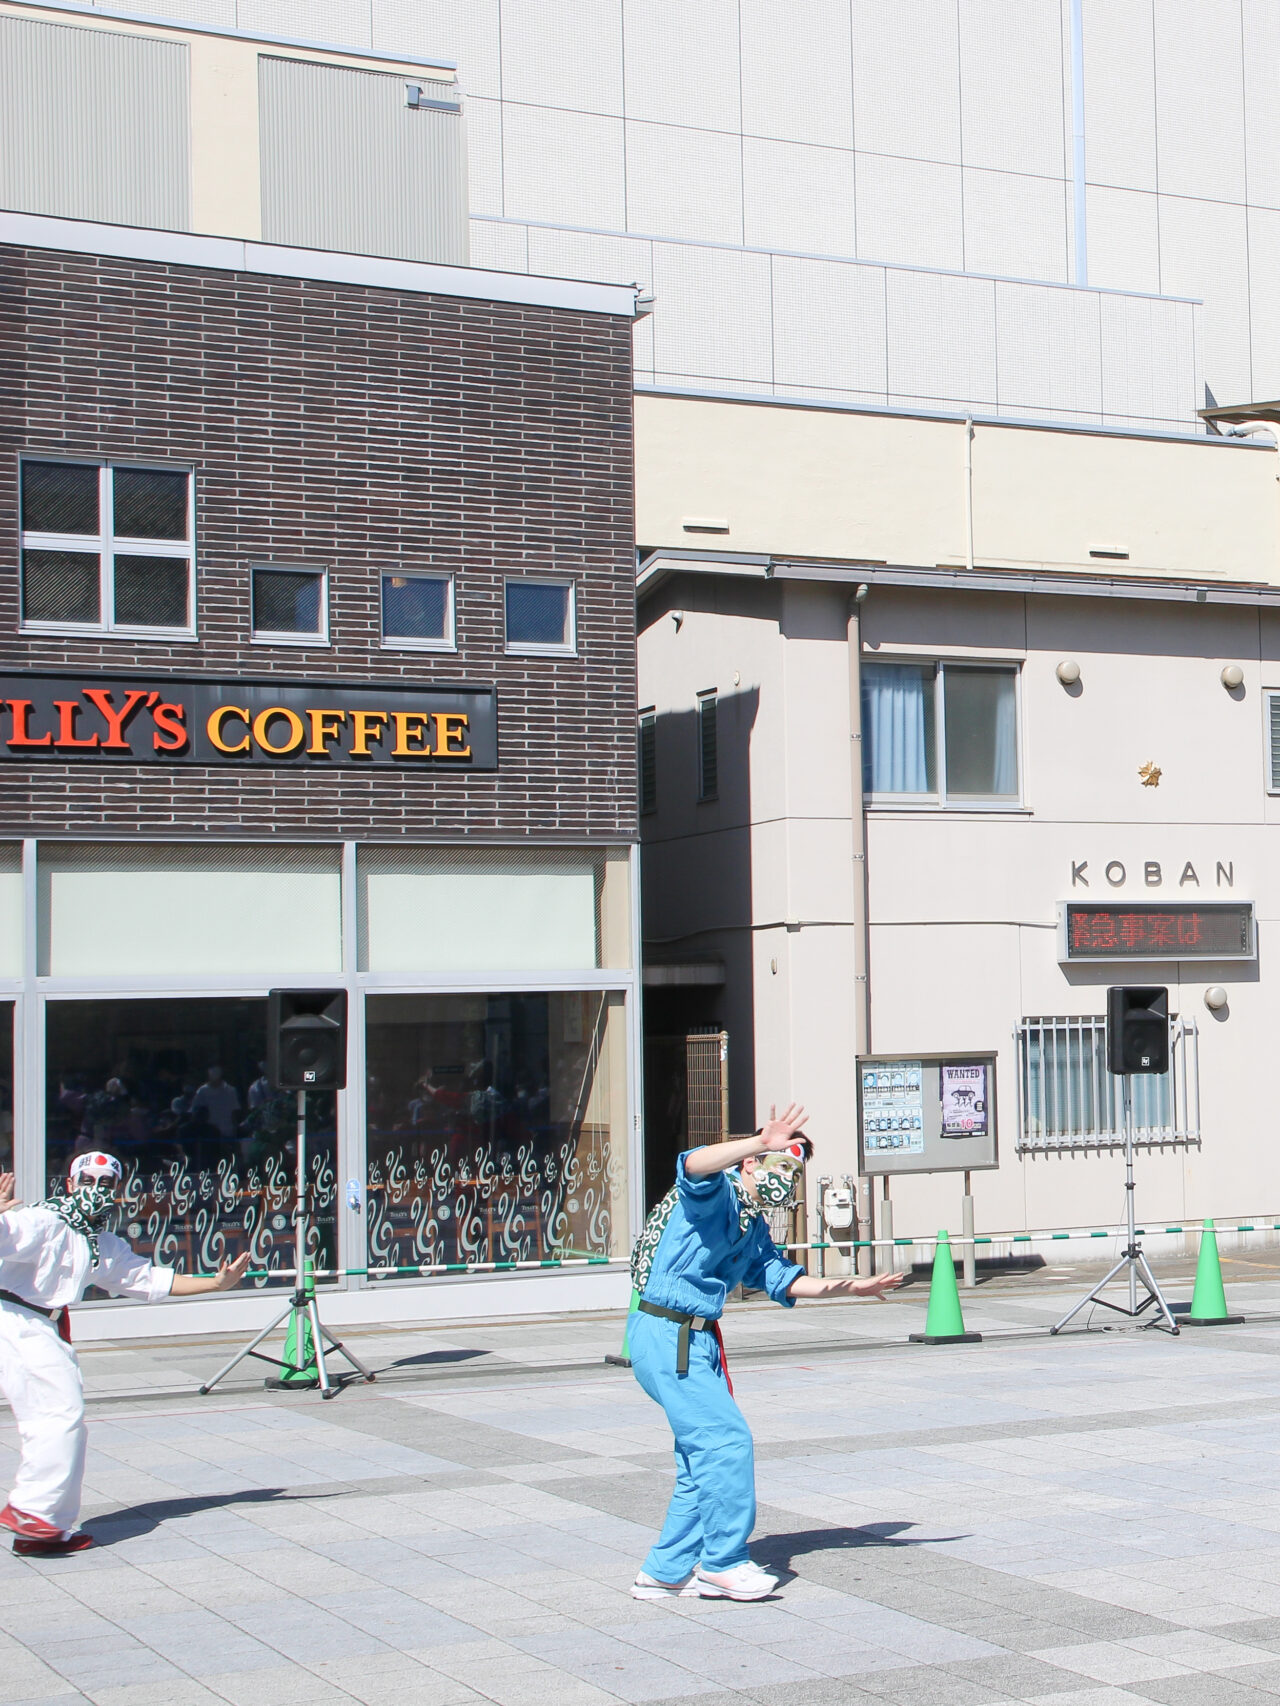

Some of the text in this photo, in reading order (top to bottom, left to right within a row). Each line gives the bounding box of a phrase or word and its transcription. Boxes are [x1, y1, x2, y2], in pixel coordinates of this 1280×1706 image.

[0, 689, 471, 757] LLY'S COFFEE
[1071, 861, 1234, 887] KOBAN
[1072, 913, 1203, 947] 緊急事案は
[946, 1069, 980, 1080] WANTED
